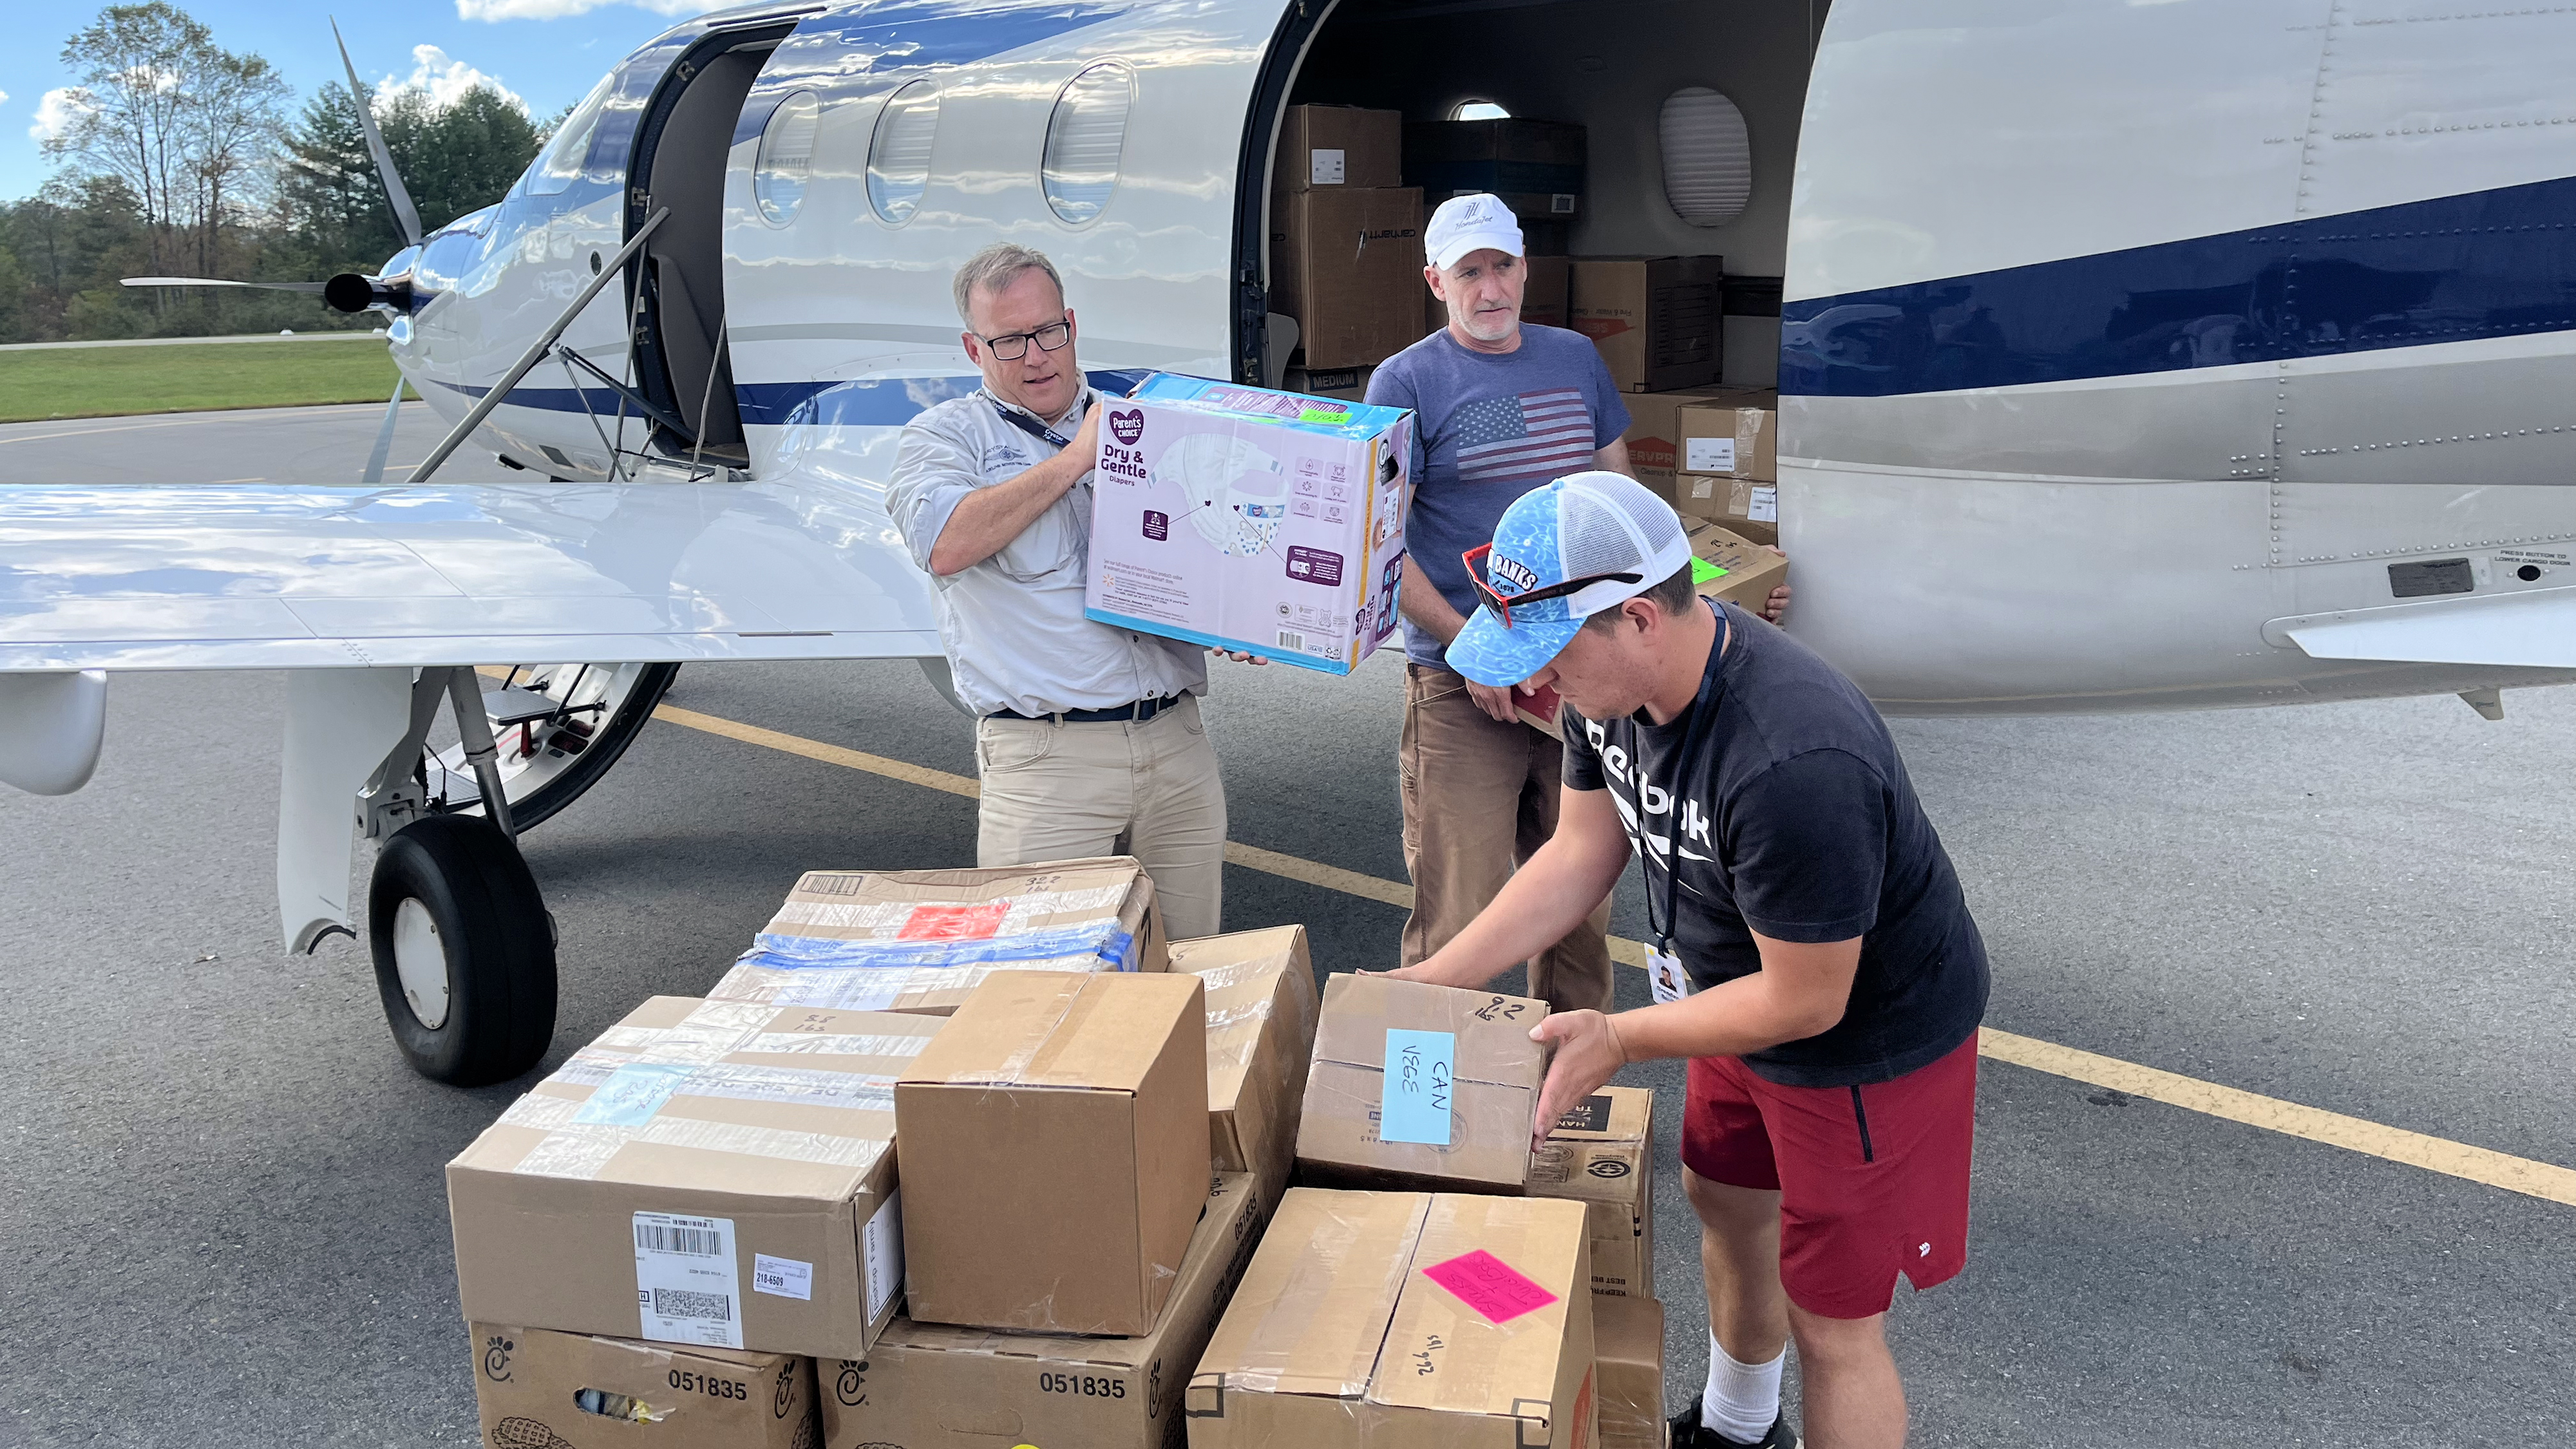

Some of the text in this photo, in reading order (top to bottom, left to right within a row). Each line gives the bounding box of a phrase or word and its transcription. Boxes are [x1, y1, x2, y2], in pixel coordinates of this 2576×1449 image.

[1369, 229, 1416, 239] carhartt
[1314, 374, 1354, 388] MEDIUM
[1113, 415, 1141, 429] Parent's
[1118, 429, 1138, 437] CHOICE
[1105, 444, 1143, 464] Dry &
[1101, 458, 1146, 478] Gentle
[1109, 475, 1135, 486] Diapers
[1495, 554, 1539, 591] BANKS
[1402, 1045, 1421, 1094] VEGE
[1432, 1061, 1448, 1110] CAN
[1235, 1191, 1257, 1241] 051835
[757, 1273, 784, 1287] 218-6509
[1605, 1277, 1626, 1285] BEST
[1412, 1335, 1444, 1376] 26.6 lbs
[668, 1369, 747, 1401] 051835
[1039, 1372, 1125, 1399] 051835
